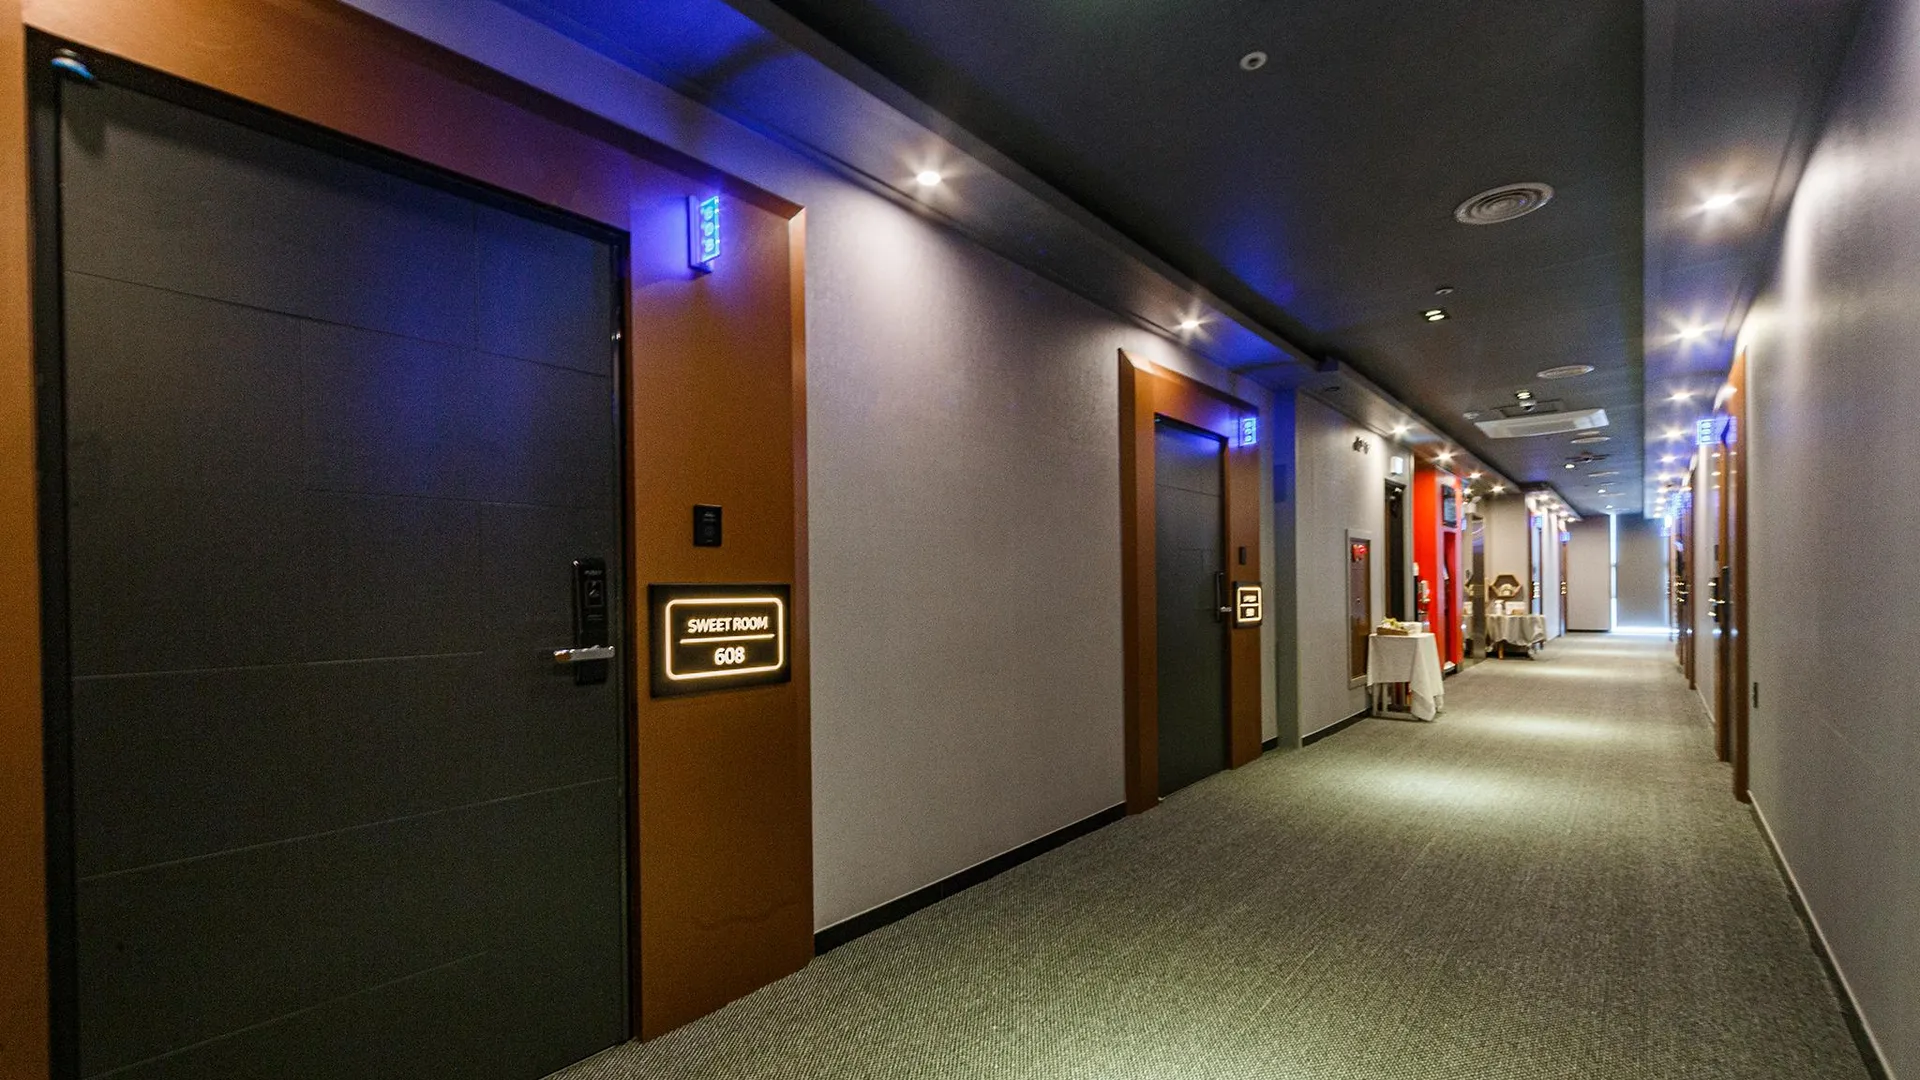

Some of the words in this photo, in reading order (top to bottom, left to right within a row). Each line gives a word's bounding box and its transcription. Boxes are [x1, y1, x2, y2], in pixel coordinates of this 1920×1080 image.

[687, 617, 732, 633] SWEET
[732, 616, 769, 631] ROOM
[714, 646, 745, 665] 608
